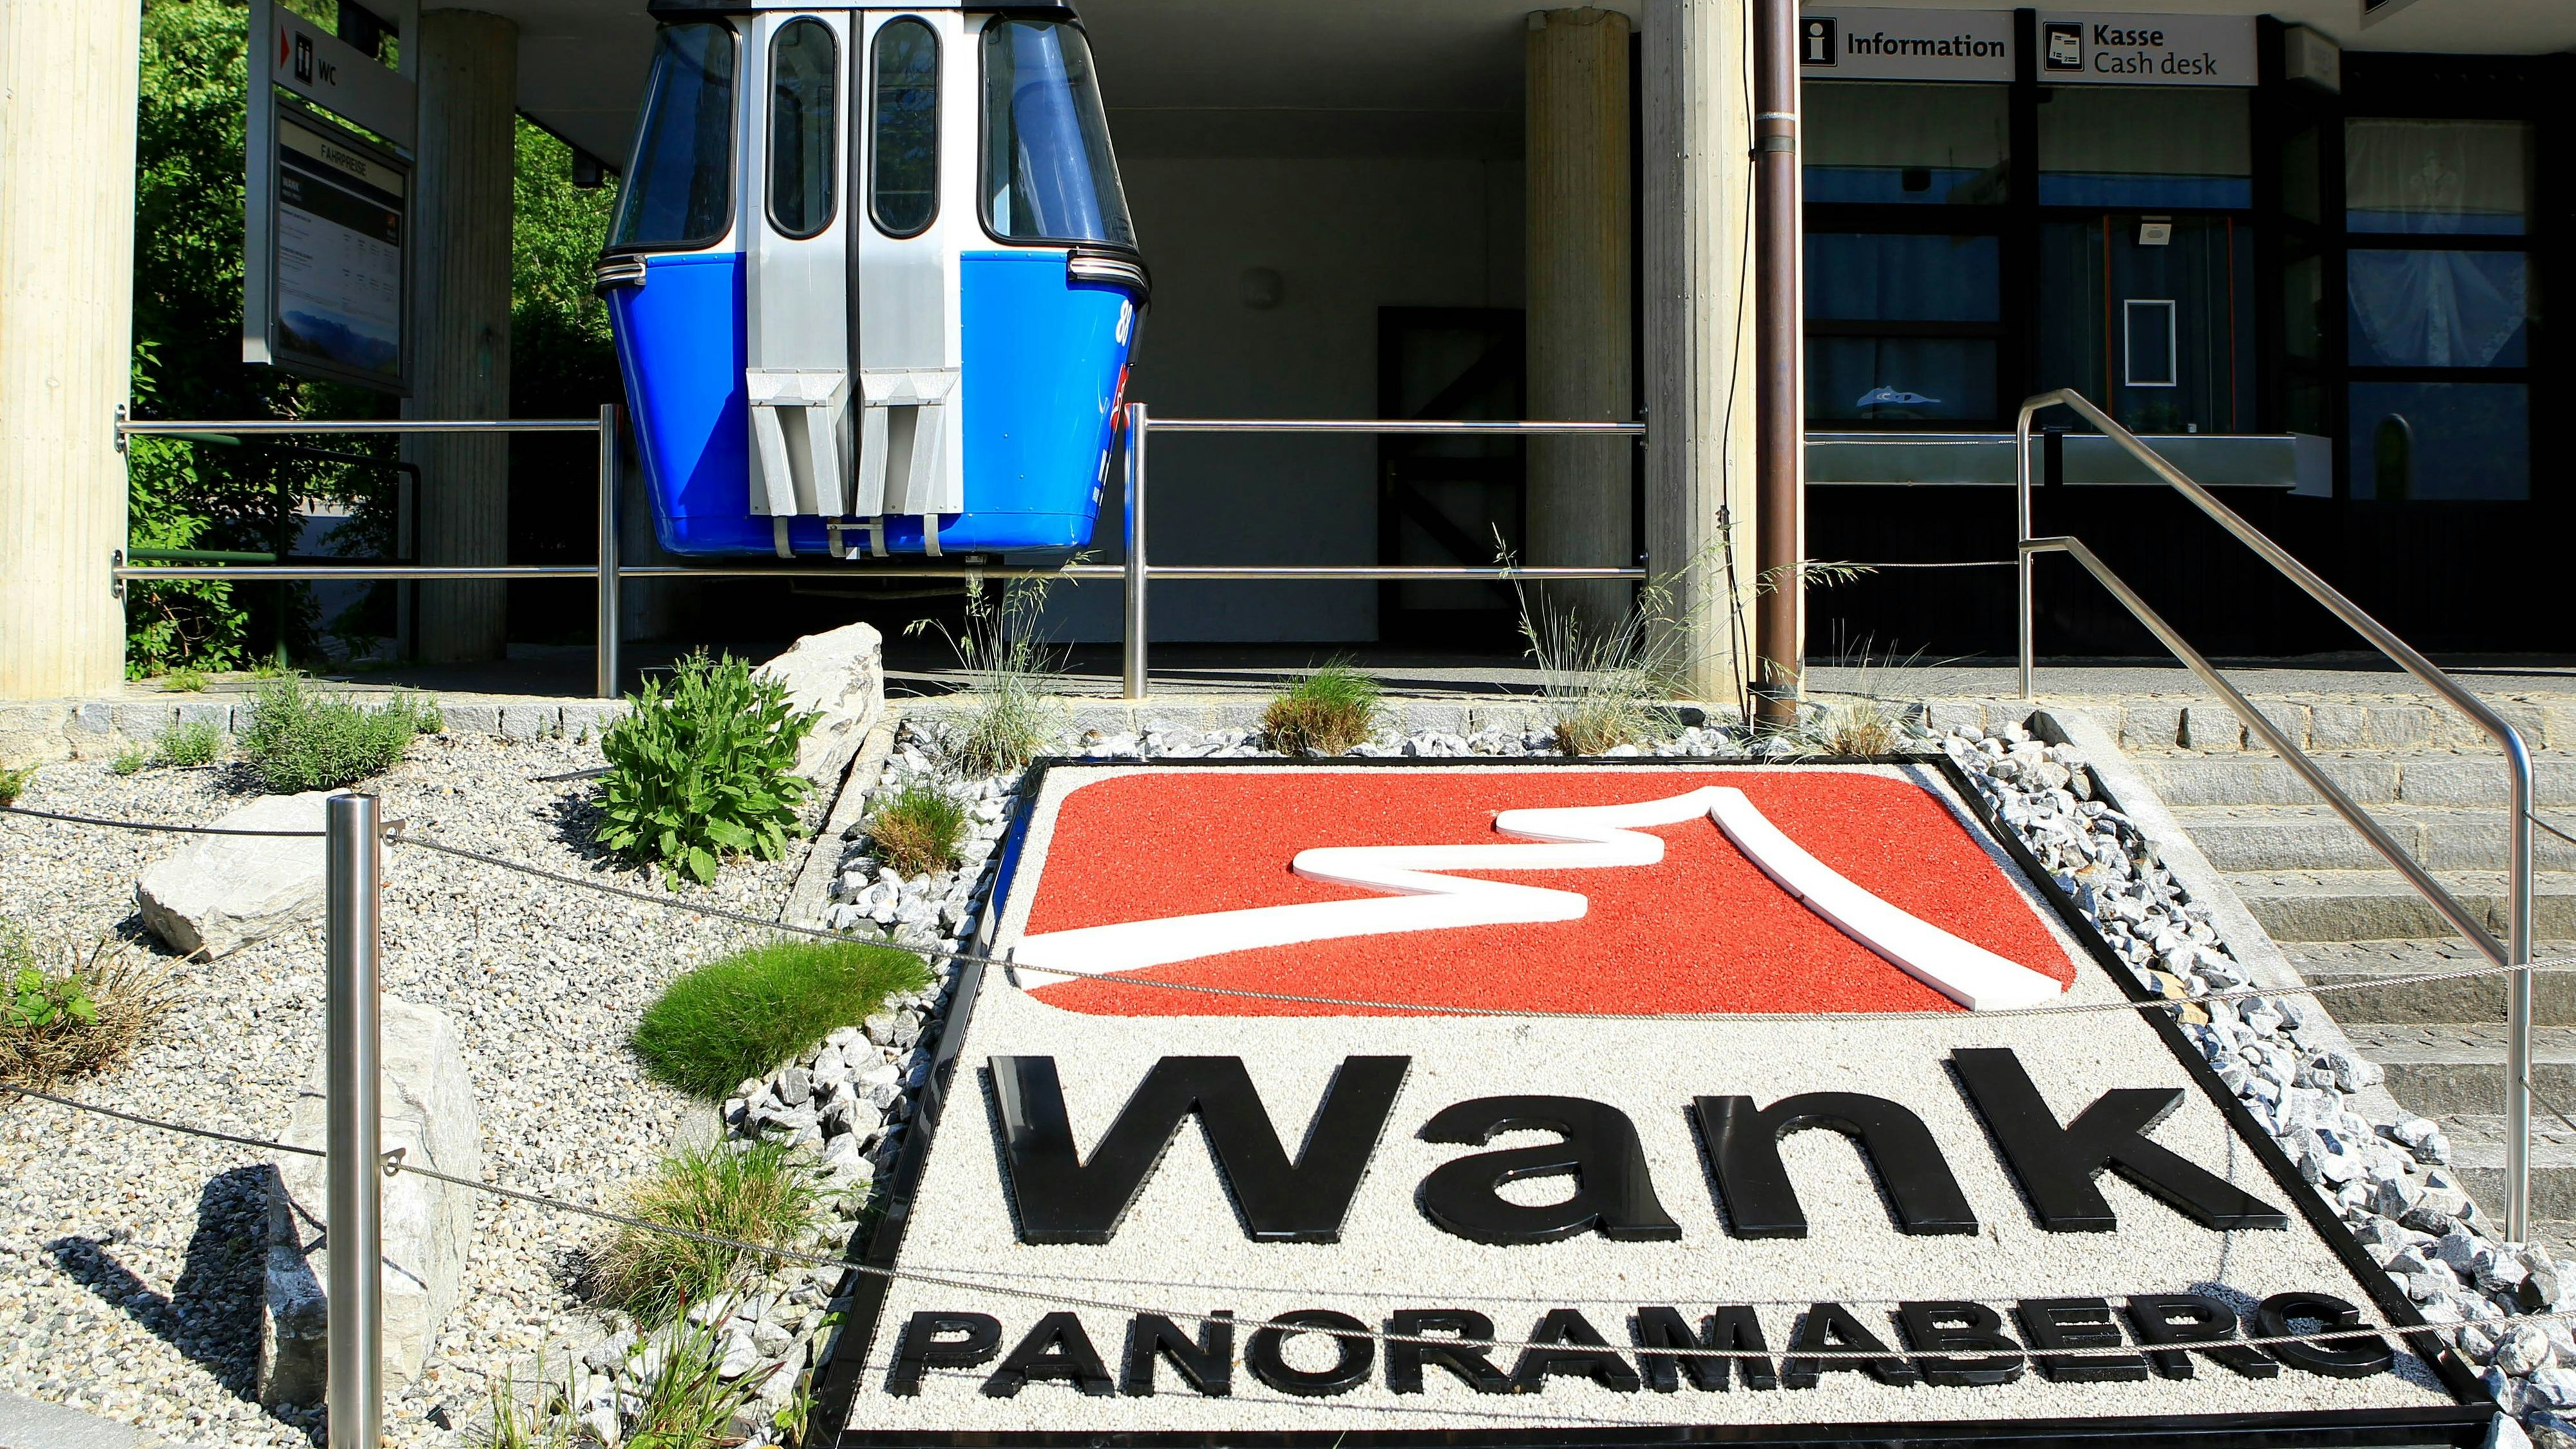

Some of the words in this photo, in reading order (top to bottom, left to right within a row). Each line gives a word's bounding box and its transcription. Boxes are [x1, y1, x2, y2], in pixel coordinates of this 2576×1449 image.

[1848, 32, 2005, 57] Information
[2094, 24, 2164, 47] Kasse
[318, 58, 337, 86] WC
[2094, 52, 2153, 73] Cash
[2161, 52, 2217, 75] desk
[321, 144, 366, 176] FAHRPREISE
[987, 1048, 2288, 1245] Wank
[884, 1292, 2394, 1399] PANORAMABERG
